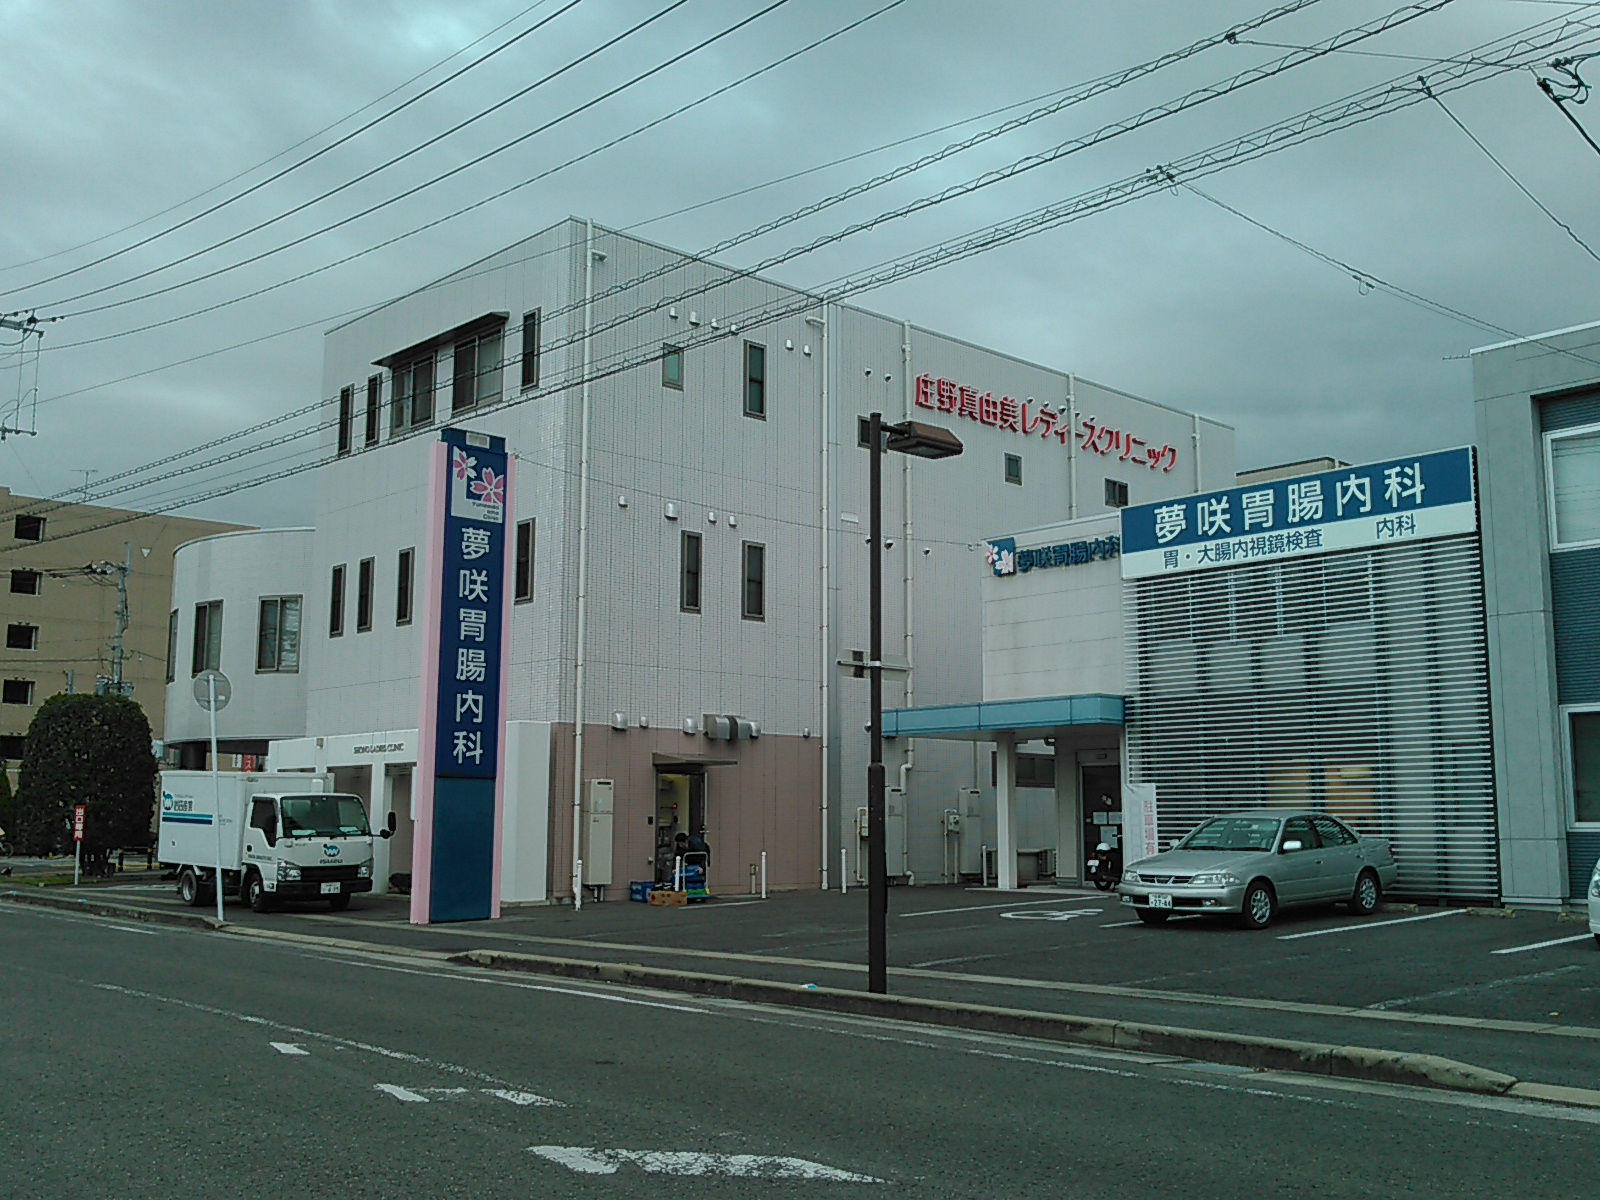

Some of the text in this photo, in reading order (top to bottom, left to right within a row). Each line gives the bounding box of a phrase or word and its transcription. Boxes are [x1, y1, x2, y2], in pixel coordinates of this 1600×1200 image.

[1154, 462, 1426, 545] 夢咲胃腸内科
[1376, 513, 1416, 540] 内科
[1018, 534, 1120, 573] 夢咲胃腸内科
[1163, 528, 1324, 569] 胃・大腸内視鏡検査
[453, 526, 492, 766] 夢咲胃腸内科
